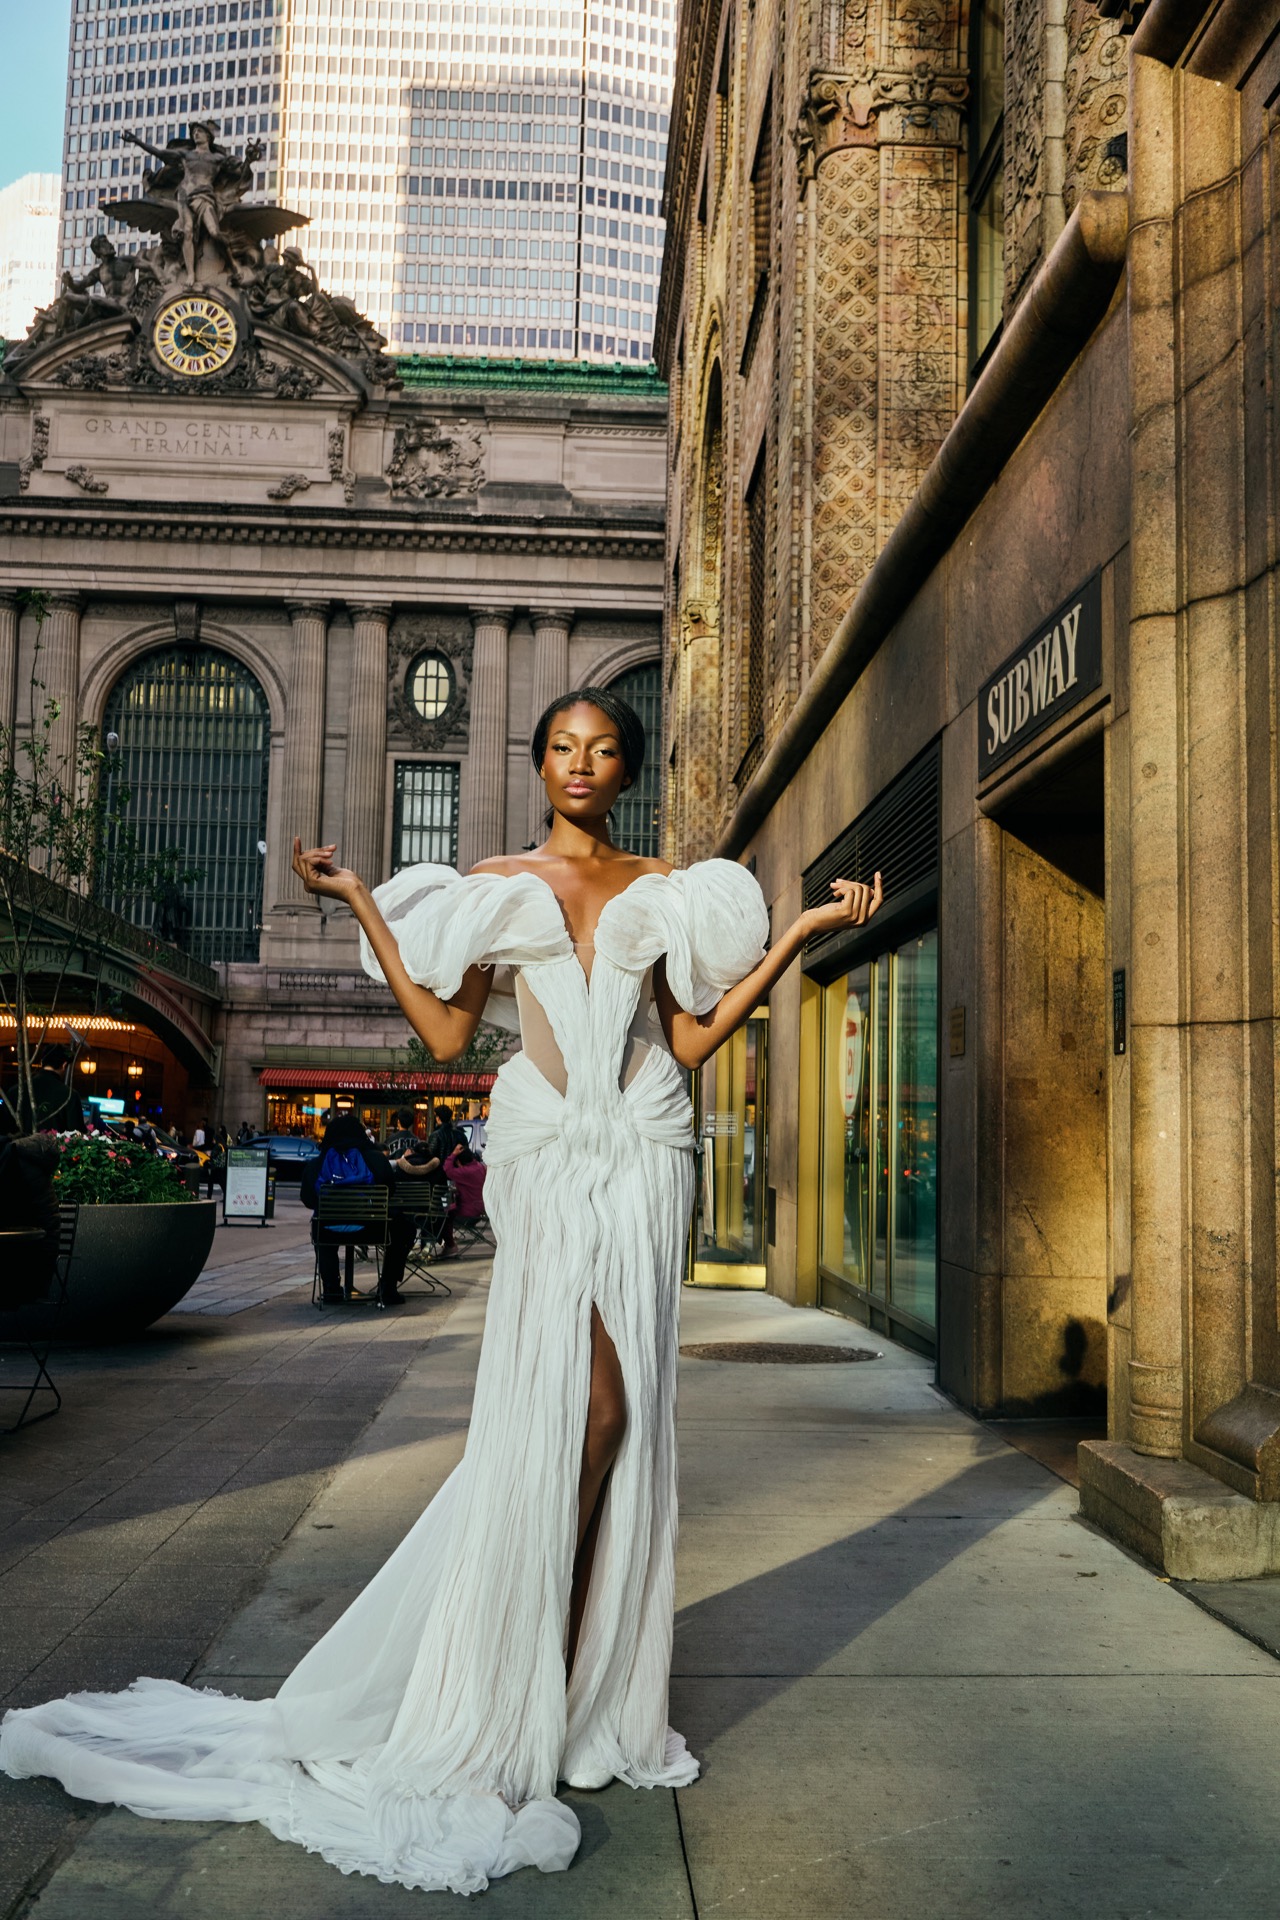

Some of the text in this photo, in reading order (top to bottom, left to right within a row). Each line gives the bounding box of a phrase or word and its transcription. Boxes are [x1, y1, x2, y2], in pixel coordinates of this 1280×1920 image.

[85, 418, 294, 441] GRAND CENTRAL
[130, 437, 248, 456] TERMINAL
[987, 603, 1082, 755] SUBWAY
[338, 1081, 373, 1089] CHARLES
